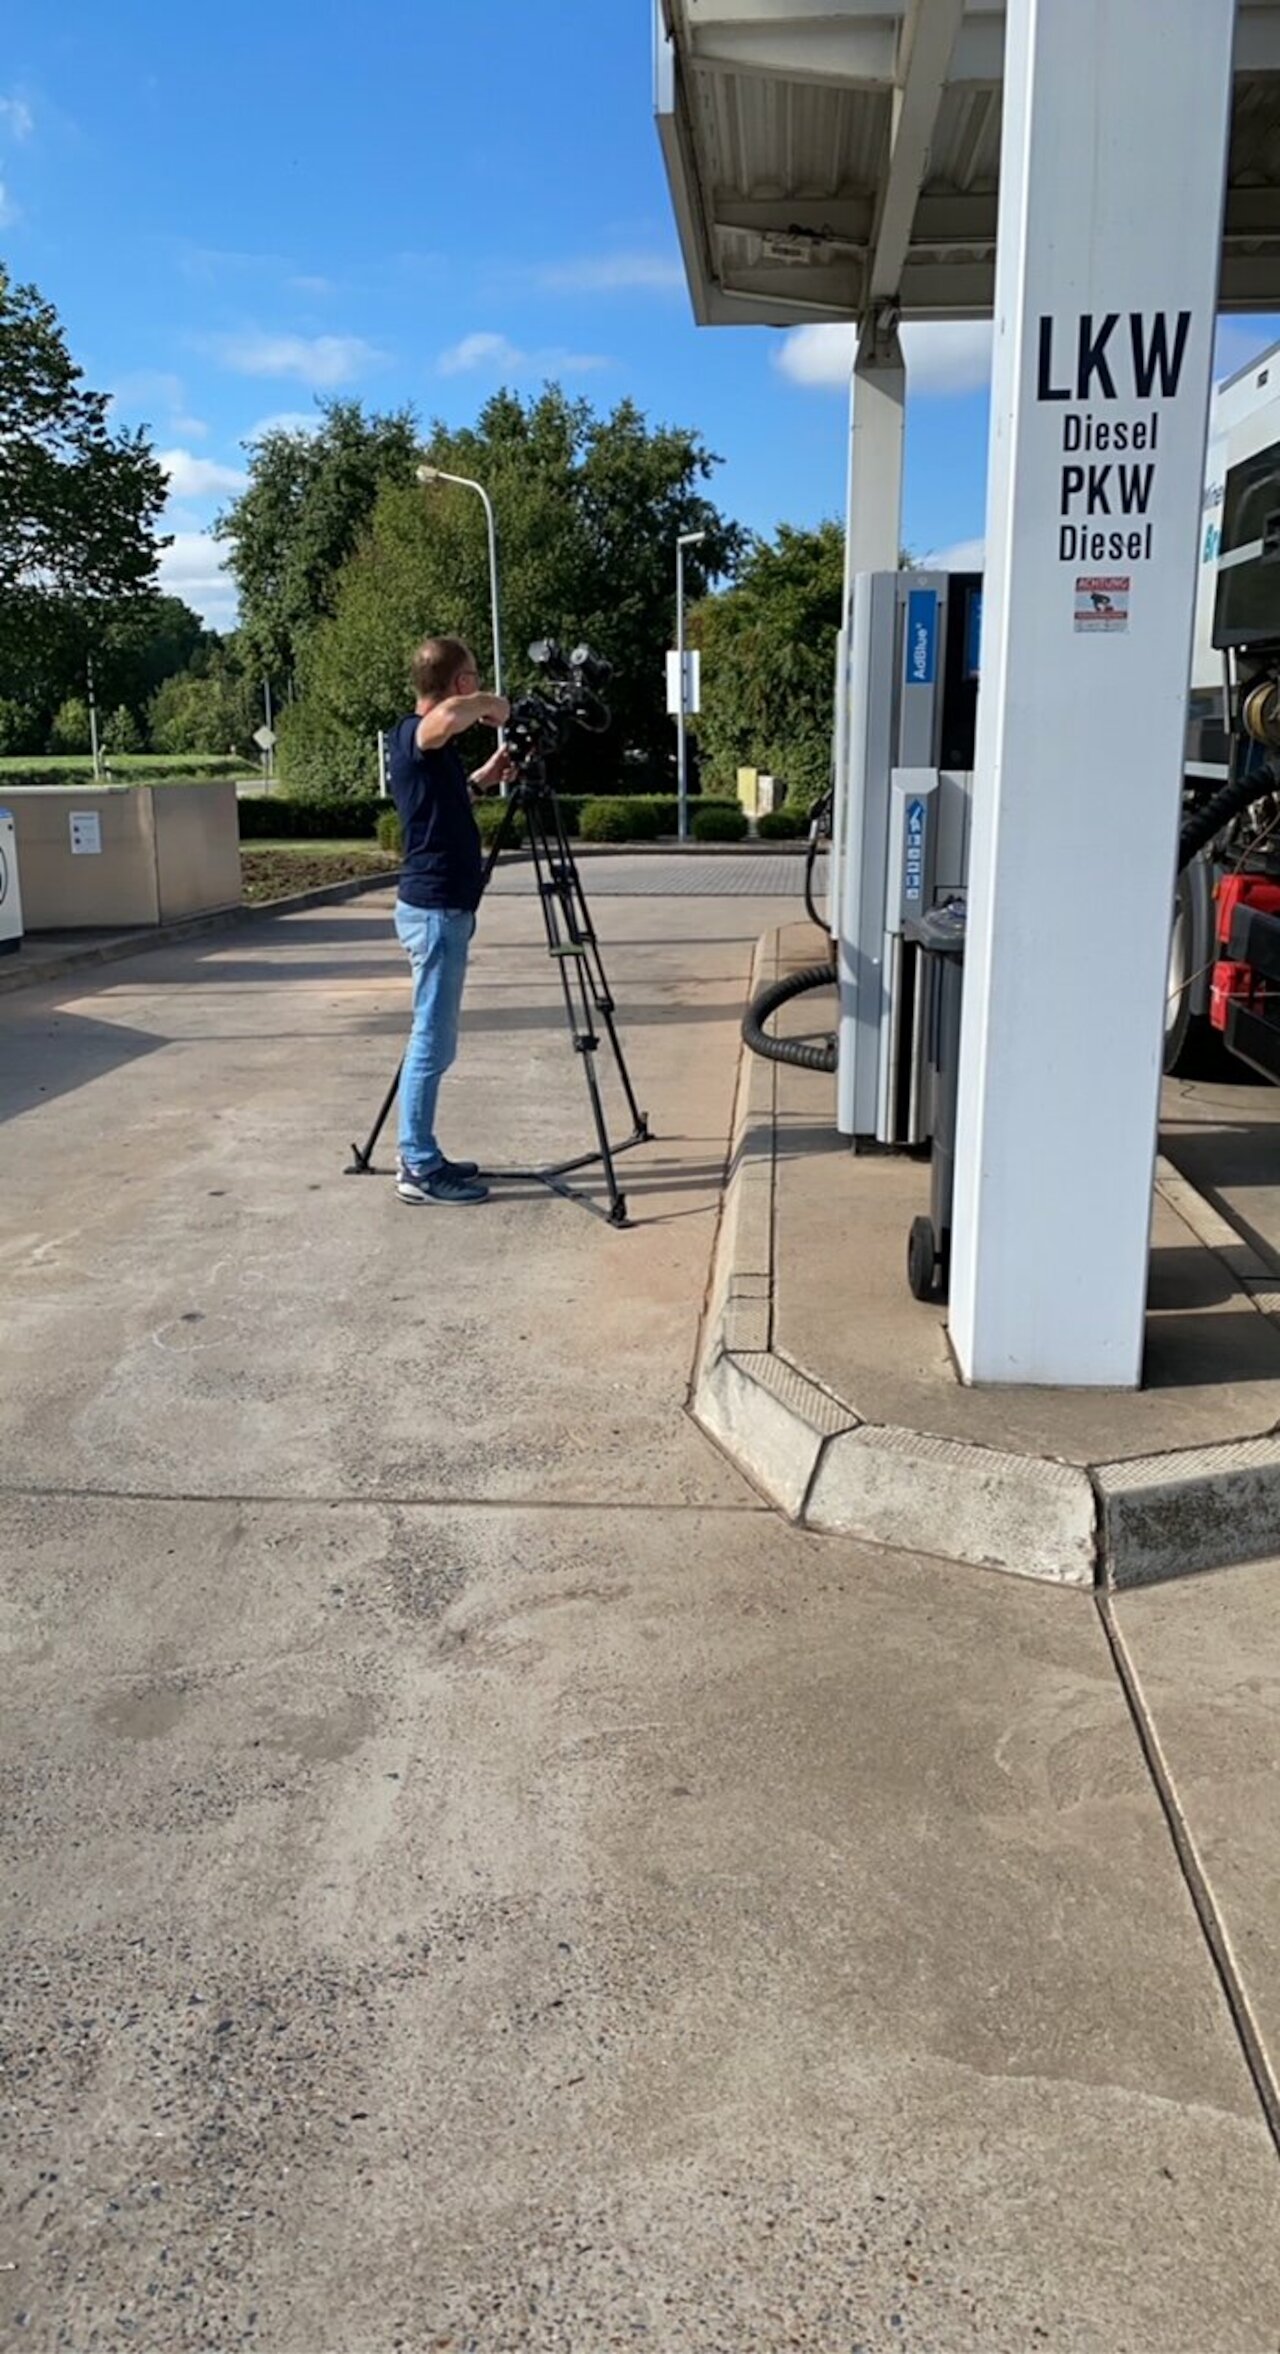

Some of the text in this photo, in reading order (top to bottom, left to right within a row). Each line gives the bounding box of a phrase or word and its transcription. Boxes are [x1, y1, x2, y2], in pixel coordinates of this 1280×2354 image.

[1037, 311, 1192, 401] LKW
[1063, 413, 1159, 452] Diesel
[1060, 464, 1156, 516] PKW
[1059, 524, 1153, 562] Diesel
[1077, 578, 1128, 591] ACHTUNG
